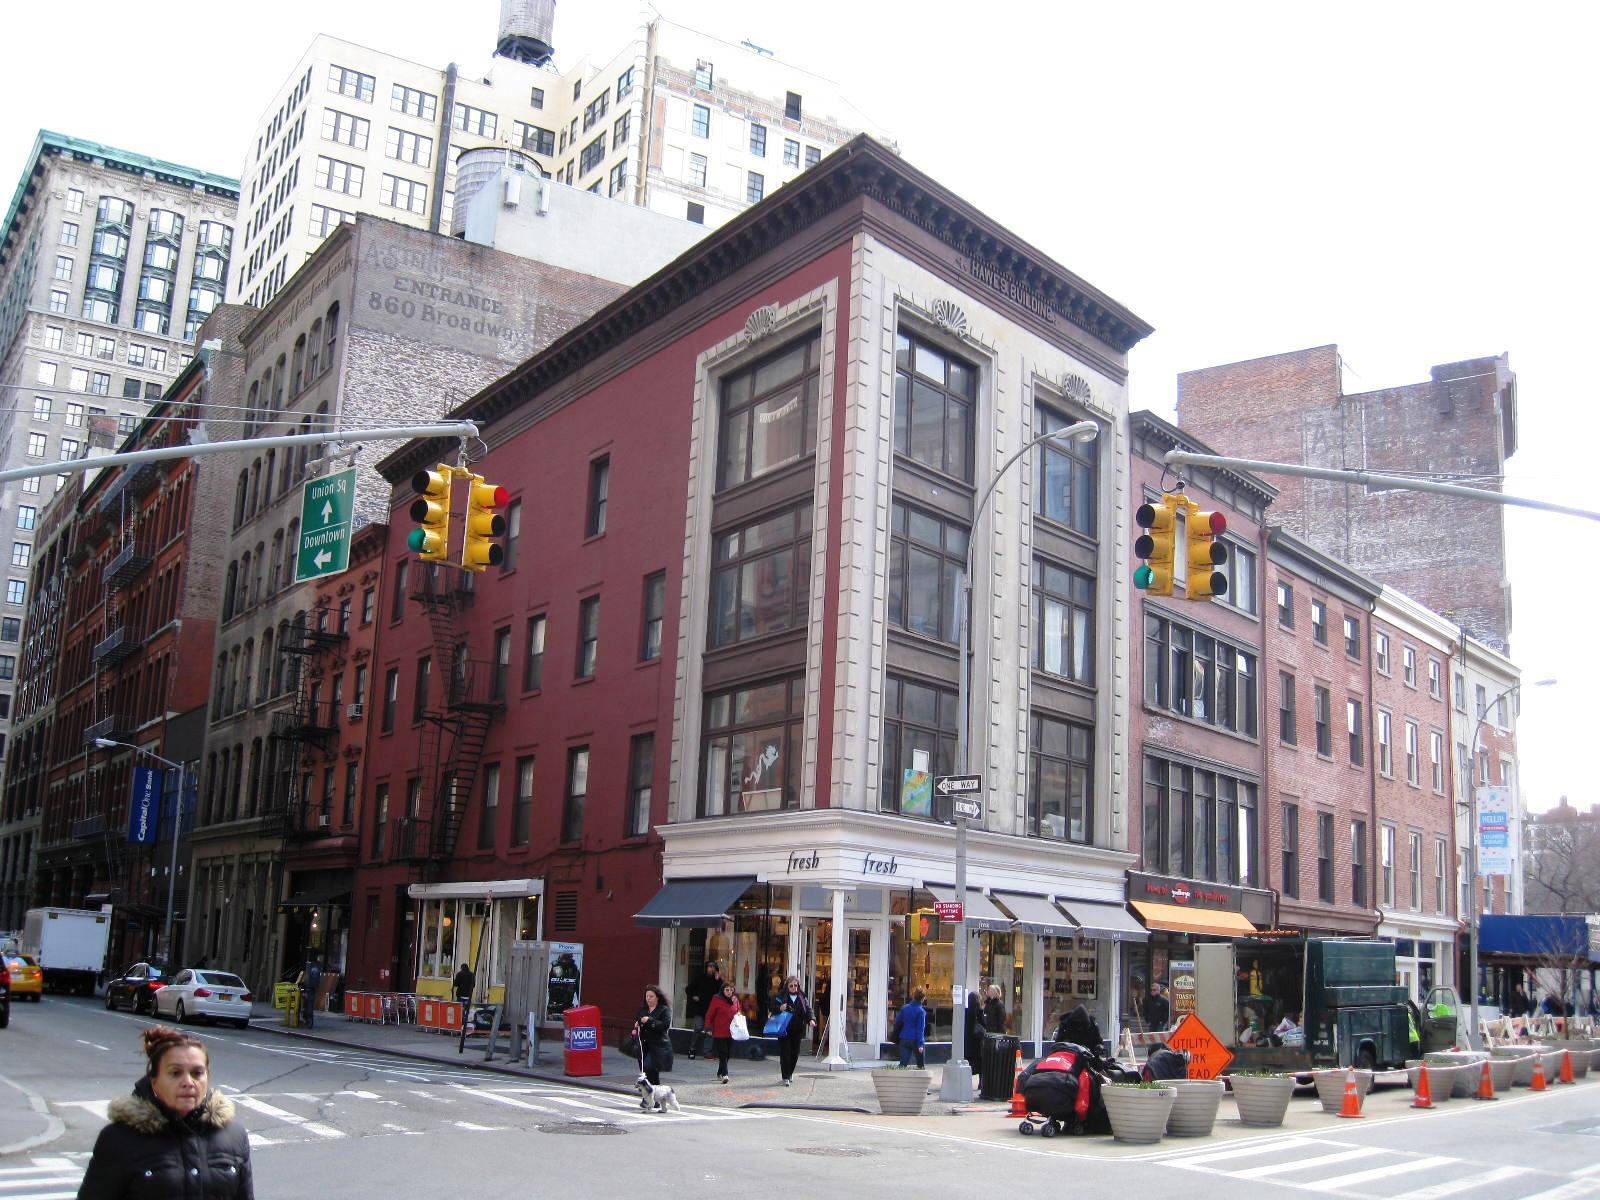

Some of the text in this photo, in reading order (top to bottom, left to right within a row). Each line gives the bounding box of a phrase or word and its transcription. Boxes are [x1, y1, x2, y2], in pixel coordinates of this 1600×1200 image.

[393, 277, 503, 315] ENTRANCE
[972, 260, 1055, 323] HAWES BUILDING
[368, 292, 416, 318] 860
[312, 479, 347, 500] Union Sq
[304, 528, 345, 549] Downtown
[941, 781, 976, 790] ONE WAY
[1481, 815, 1505, 824] HELLO!
[787, 850, 820, 874] fresh
[862, 852, 898, 875] fresh
[573, 1030, 595, 1040] VOICE
[1173, 1039, 1211, 1049] UTILITY
[1190, 1053, 1206, 1064] RK
[1188, 1069, 1211, 1080] EAD
